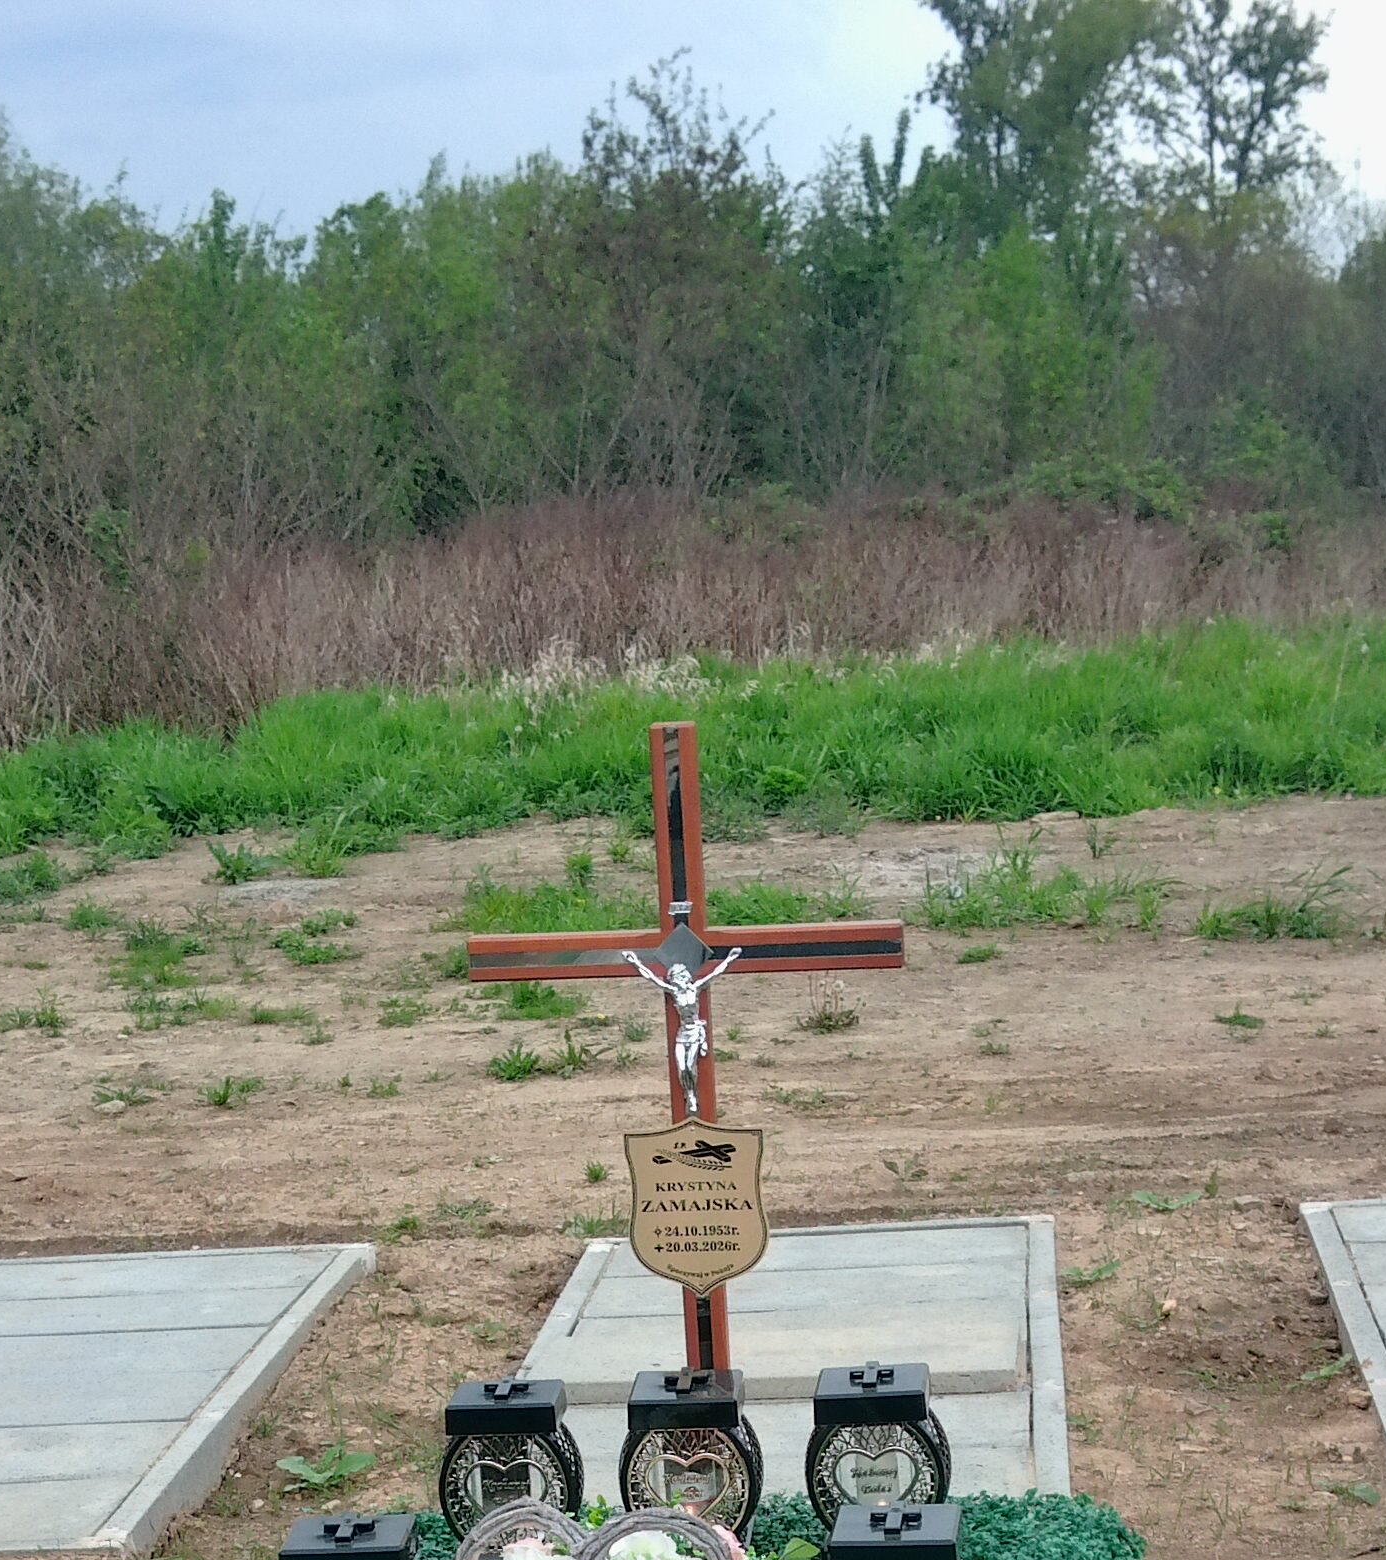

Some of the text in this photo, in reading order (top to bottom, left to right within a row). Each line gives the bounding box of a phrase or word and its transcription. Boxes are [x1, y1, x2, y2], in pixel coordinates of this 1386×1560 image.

[655, 1181, 737, 1192] KRYSTYNA
[641, 1199, 753, 1213] ZAMAJSKA
[664, 1225, 740, 1237] 24.10.1953r.
[665, 1240, 741, 1252] 20.03.2026r.
